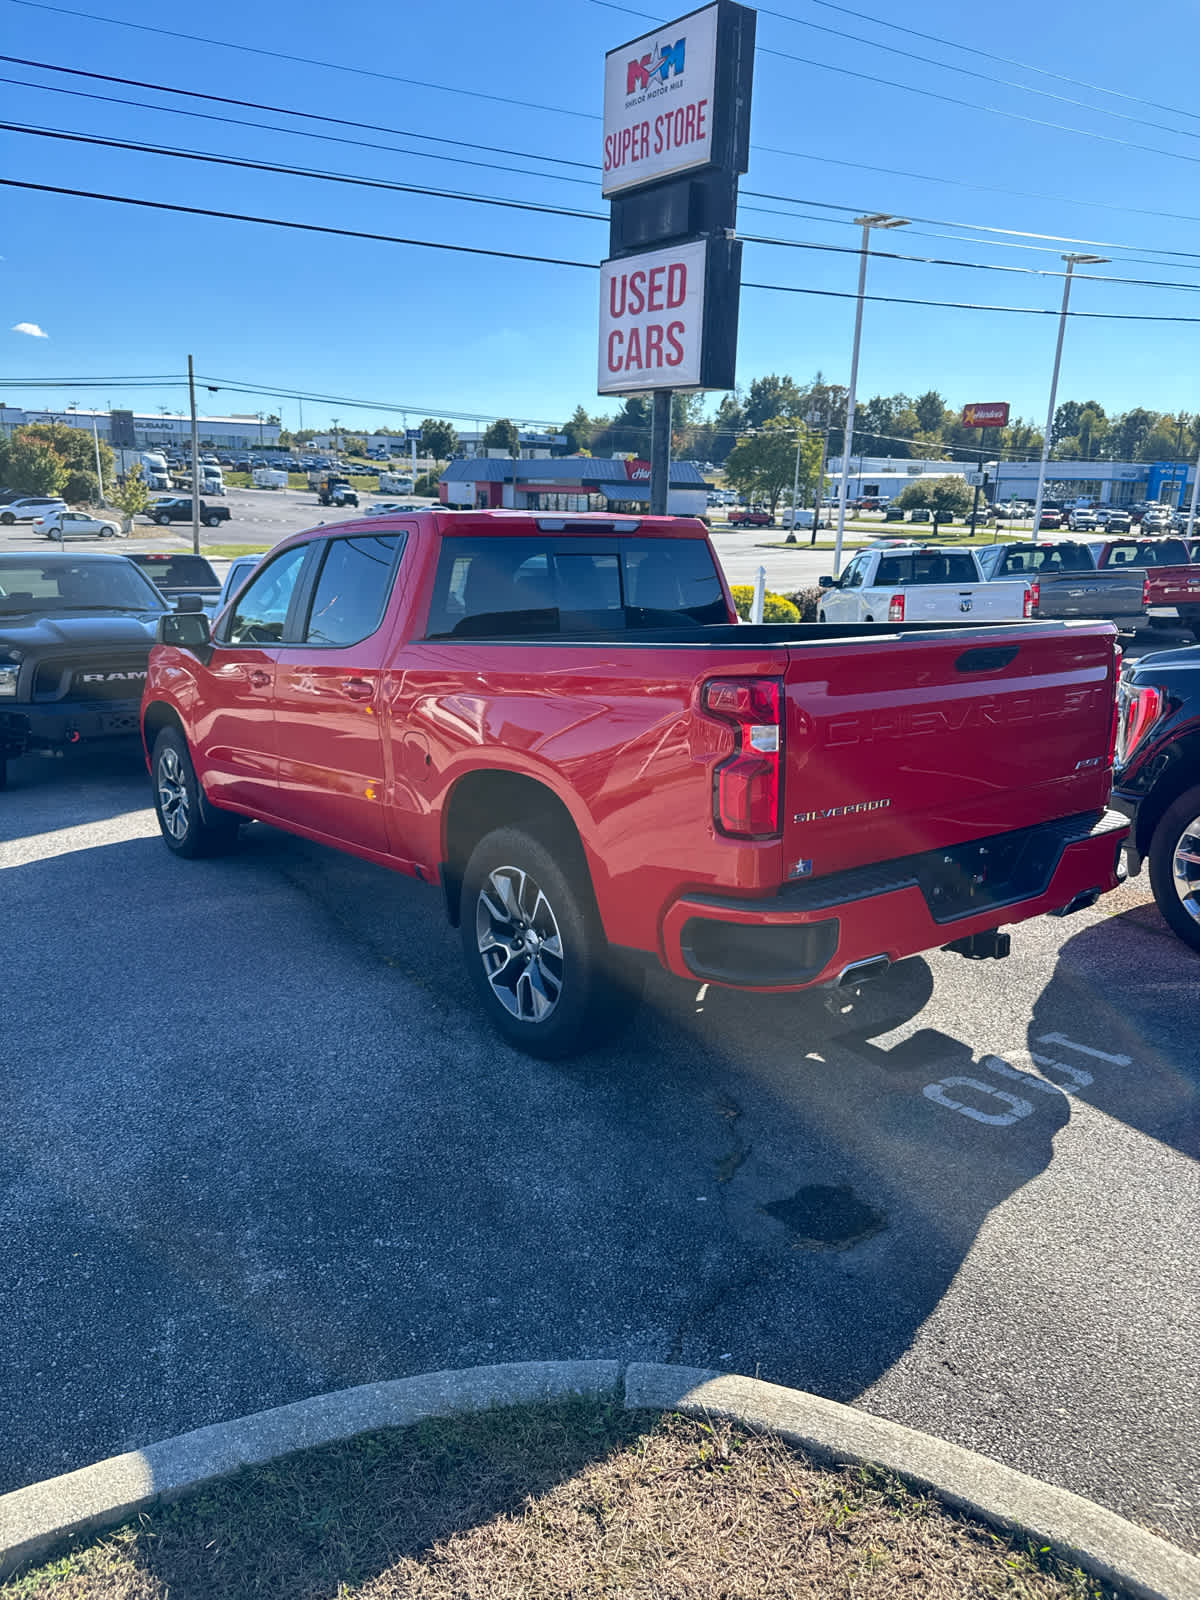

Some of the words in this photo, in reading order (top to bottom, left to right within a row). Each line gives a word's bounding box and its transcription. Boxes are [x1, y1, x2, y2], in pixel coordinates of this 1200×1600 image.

[647, 86, 668, 99] MOTOR
[670, 79, 683, 90] MILE
[604, 120, 650, 172] SUPER
[654, 99, 708, 154] STORE
[610, 262, 688, 319] USED
[607, 320, 685, 373] CARS
[83, 671, 148, 682] RAM
[825, 689, 1102, 747] CHEVROLET
[793, 798, 892, 824] SILVERADO
